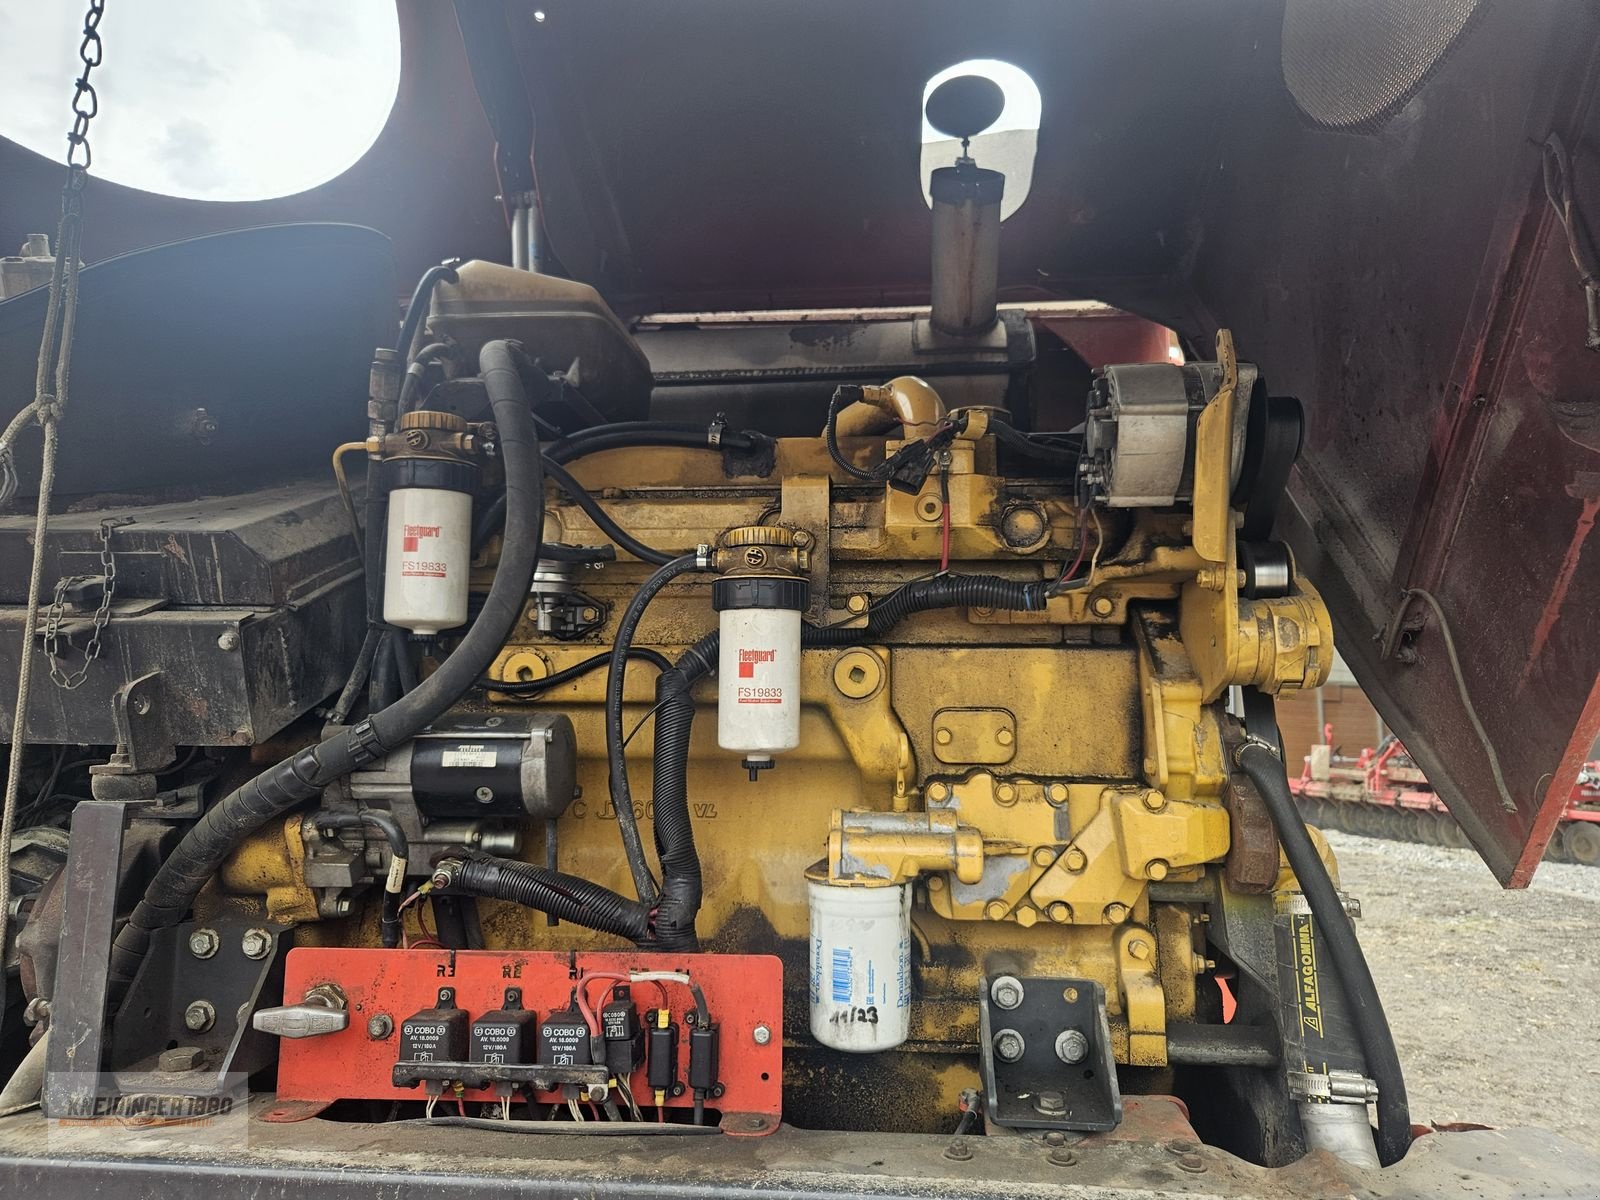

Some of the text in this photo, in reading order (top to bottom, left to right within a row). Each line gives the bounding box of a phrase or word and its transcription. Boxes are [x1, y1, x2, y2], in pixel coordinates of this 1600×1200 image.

[402, 561, 447, 571] FS19833
[739, 649, 775, 664] Fleetguard
[738, 688, 782, 697] FS19833
[1299, 924, 1317, 1011] ALFAGOMMA
[829, 1006, 878, 1024] 11/23
[414, 1026, 435, 1034] COBO
[485, 1028, 506, 1036] COBO
[553, 1028, 575, 1036] COBO
